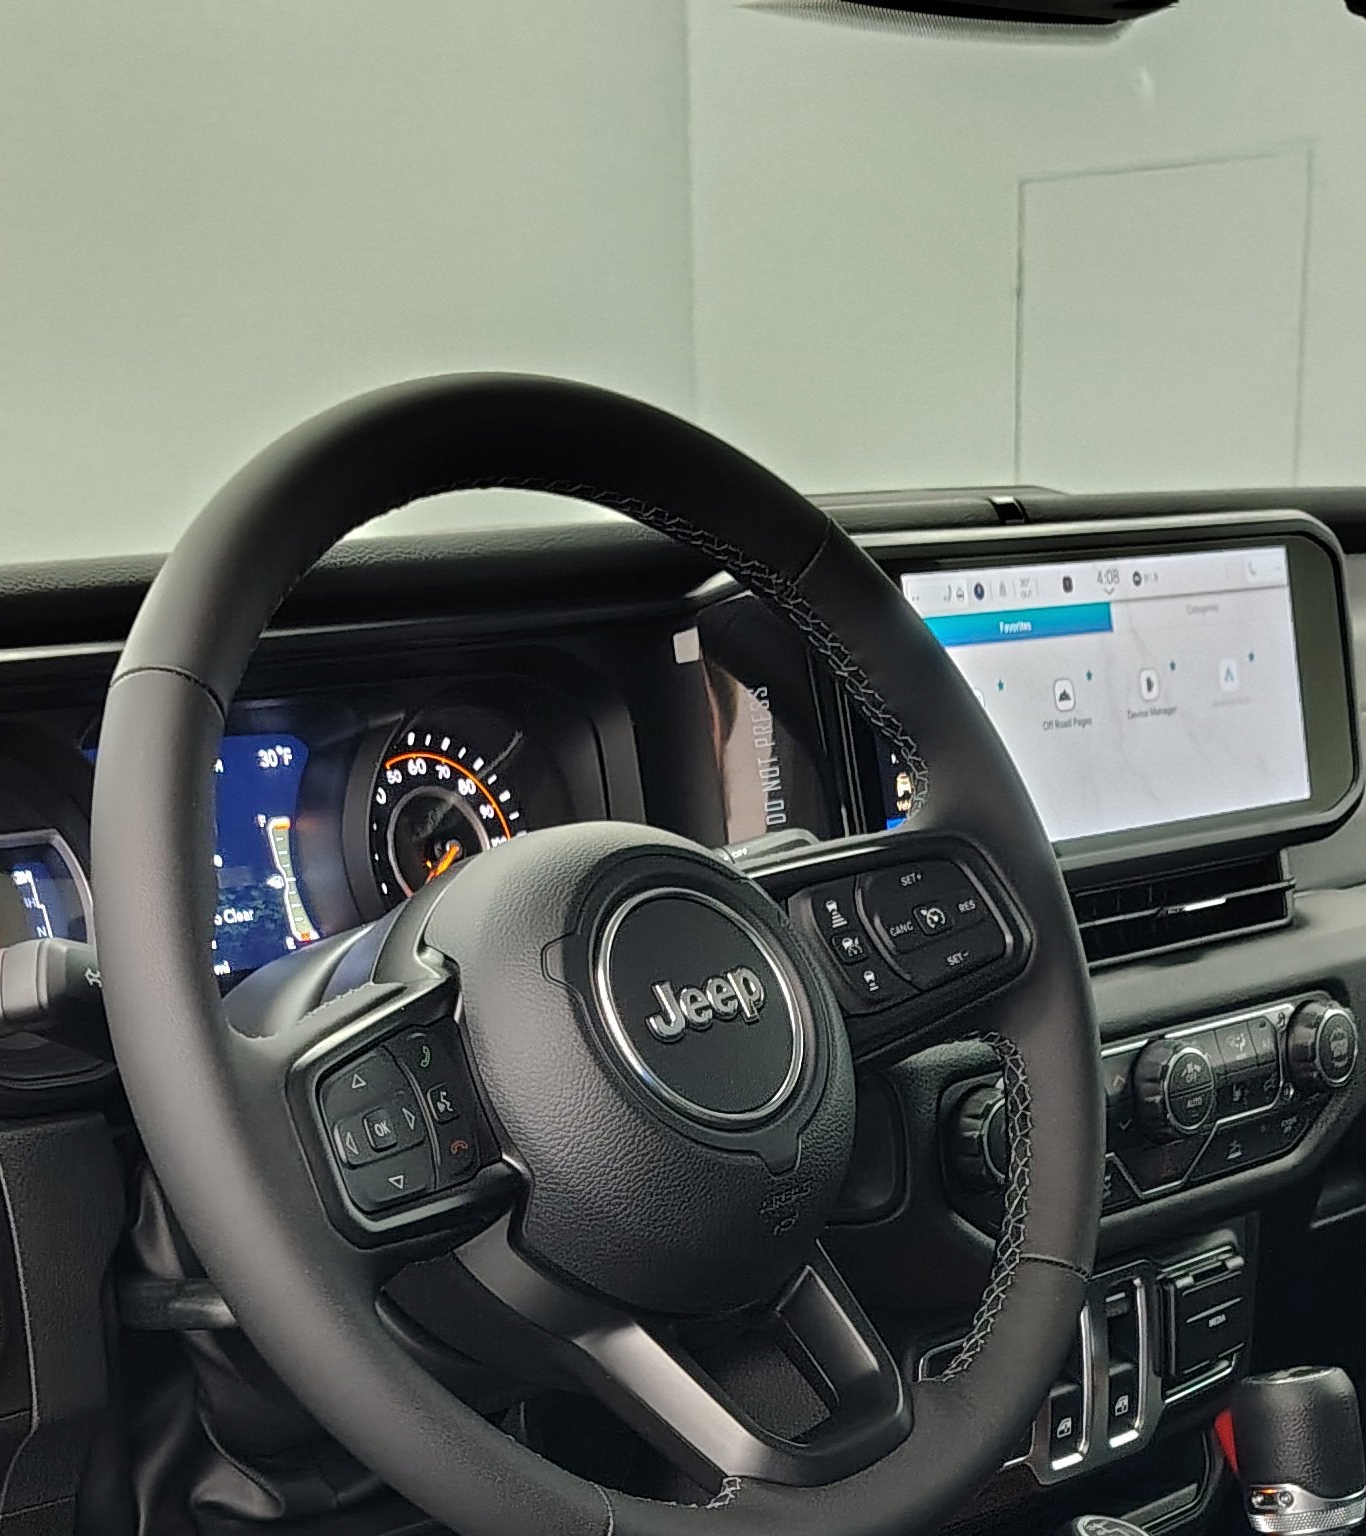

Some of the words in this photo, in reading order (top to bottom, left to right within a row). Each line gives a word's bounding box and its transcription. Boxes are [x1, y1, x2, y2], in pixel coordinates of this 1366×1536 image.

[1097, 568, 1121, 586] 4:08
[999, 619, 1033, 635] Favorites
[748, 684, 776, 748] PRESS
[1150, 704, 1178, 719] Manager
[1042, 720, 1054, 731] Off
[1055, 718, 1072, 731] Road
[1073, 716, 1093, 731] Pages
[407, 757, 427, 776] 60
[435, 764, 451, 780] 70
[755, 756, 783, 795] NOT
[386, 769, 403, 785] 50
[457, 778, 477, 796] 80
[479, 803, 495, 820] 90
[762, 797, 788, 827] DO
[957, 899, 977, 913] RES
[223, 908, 254, 925] Clear
[889, 920, 915, 938] CANC
[646, 964, 767, 1044] Jeep
[374, 1120, 393, 1138] OK
